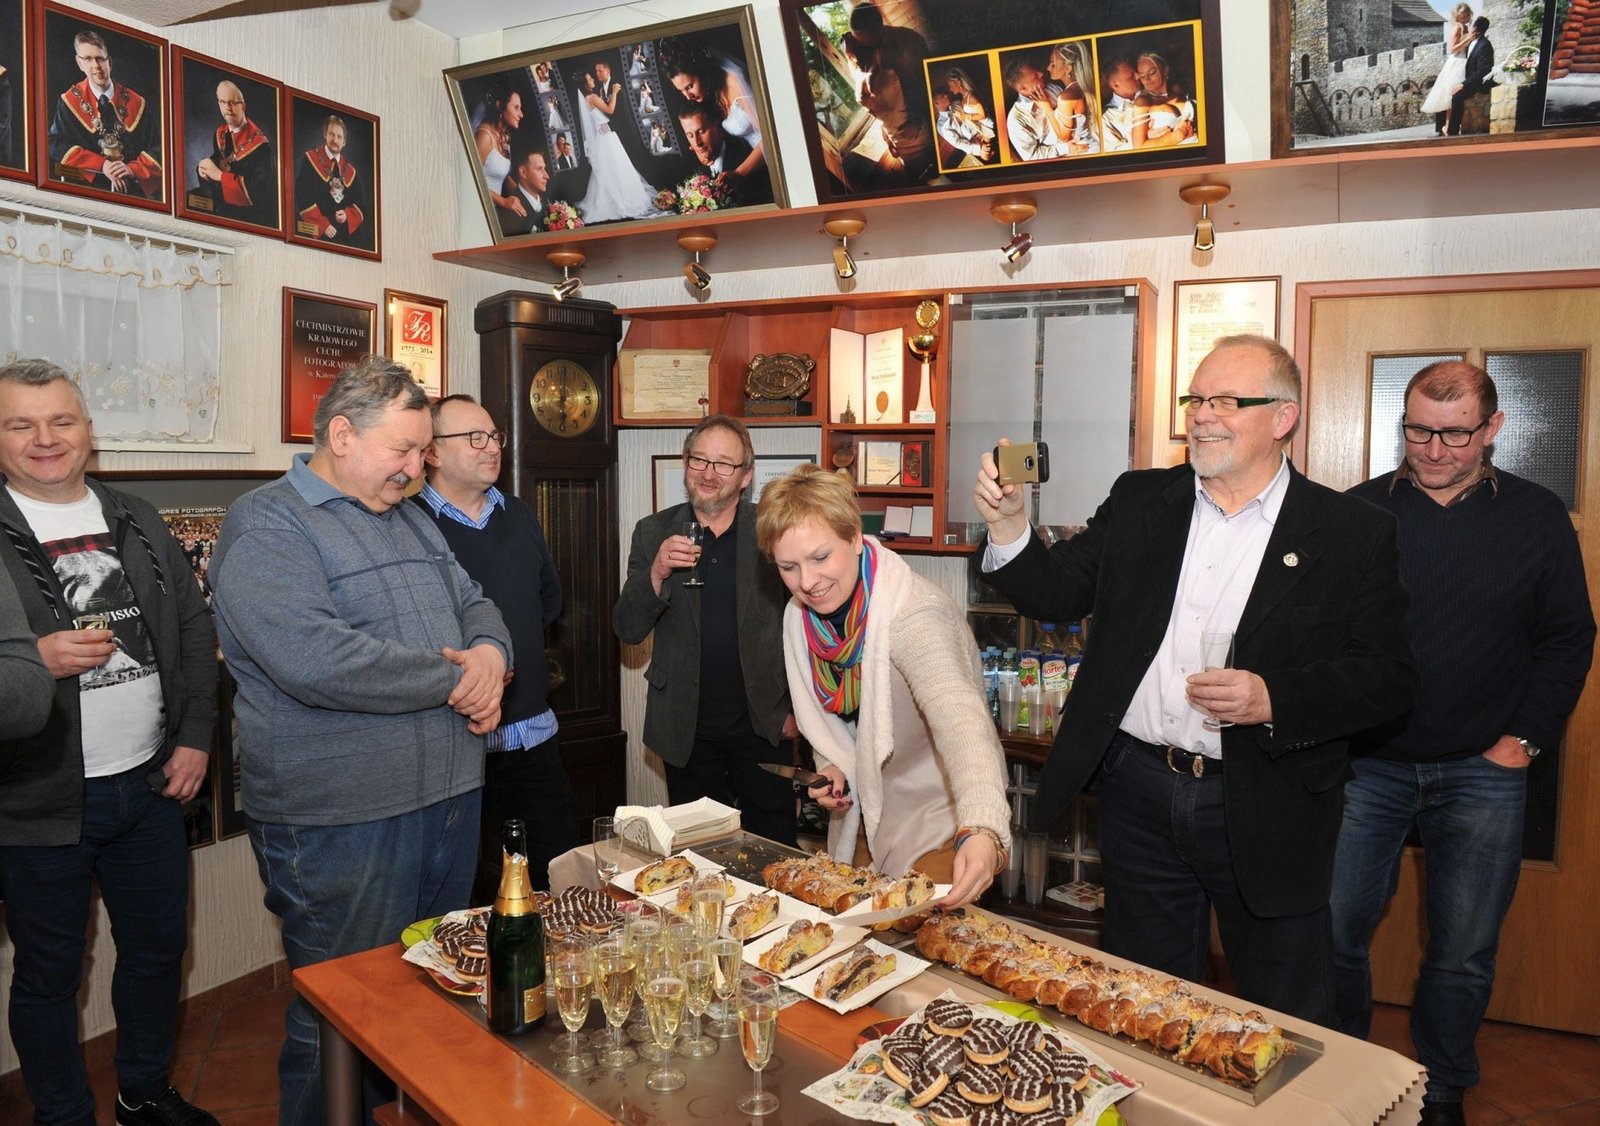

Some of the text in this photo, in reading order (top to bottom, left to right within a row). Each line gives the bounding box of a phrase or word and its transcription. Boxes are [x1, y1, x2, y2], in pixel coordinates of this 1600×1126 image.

[296, 320, 366, 337] CECHMISTRZOWIE
[308, 333, 357, 348] KRAJOWEGO
[315, 347, 342, 357] CECHU
[536, 379, 546, 388] 10
[533, 392, 541, 402] 9
[584, 395, 592, 406] 3
[580, 409, 587, 419] 4
[1043, 665, 1065, 675] Hortex
